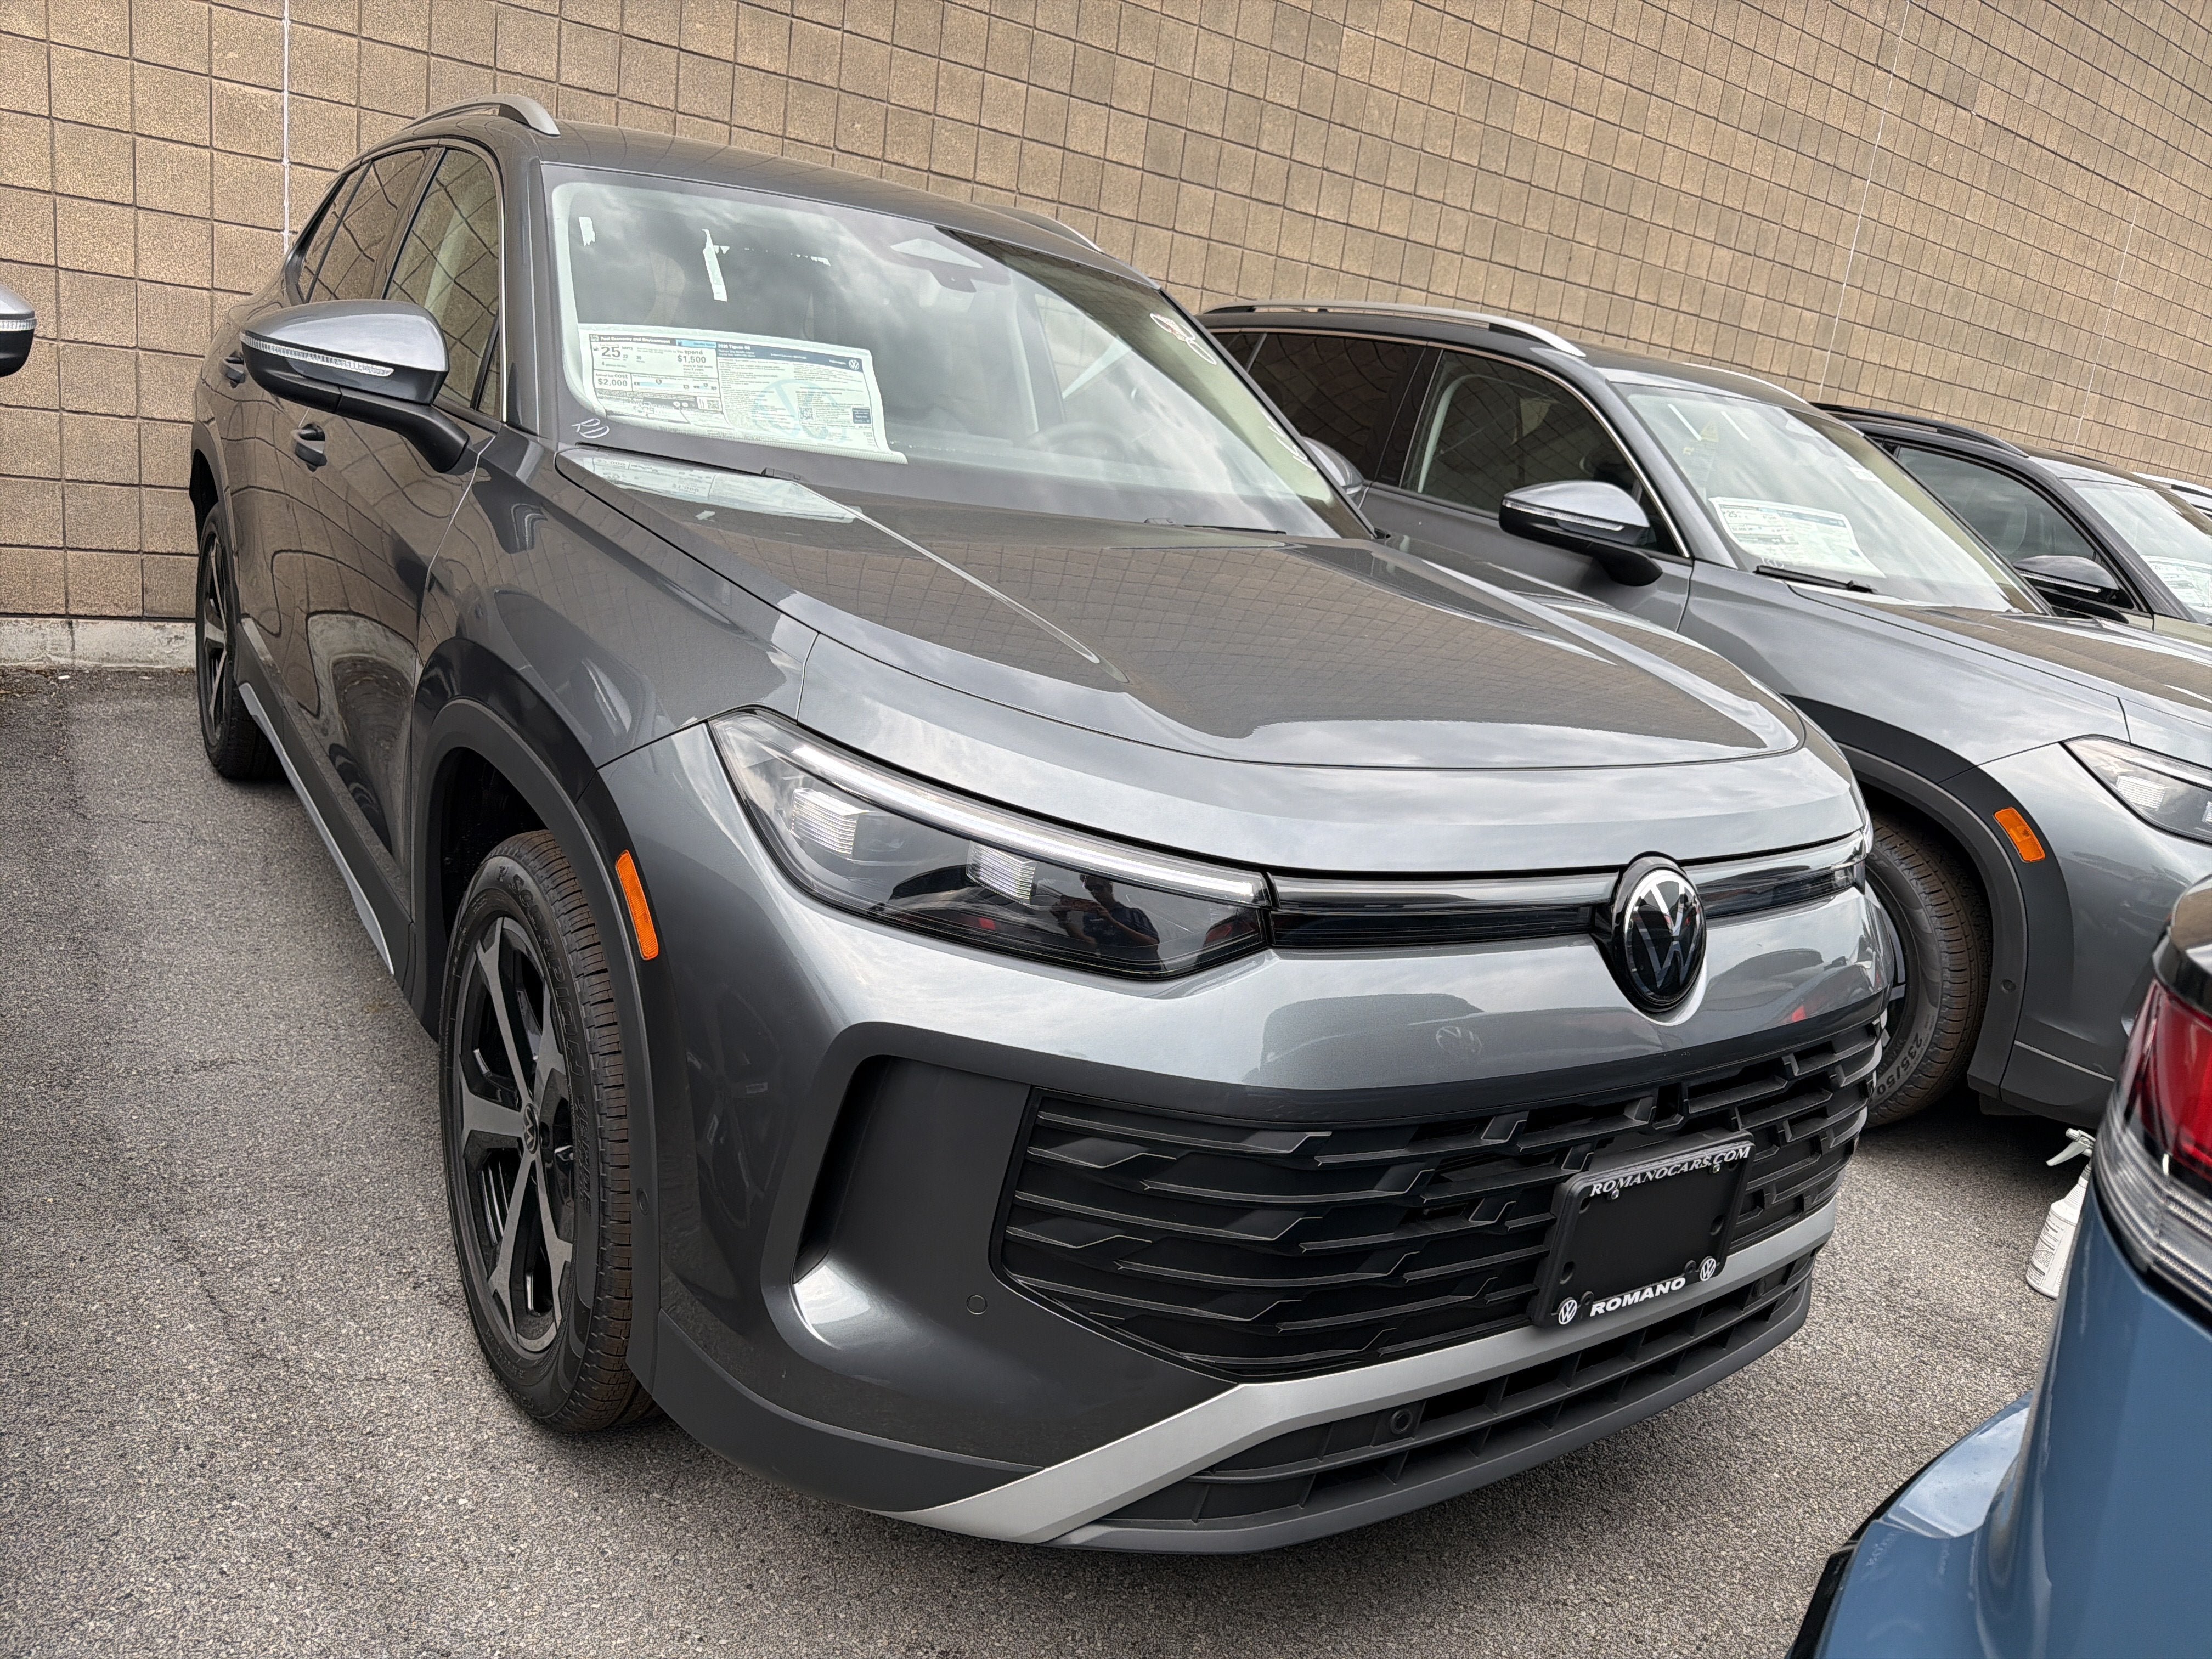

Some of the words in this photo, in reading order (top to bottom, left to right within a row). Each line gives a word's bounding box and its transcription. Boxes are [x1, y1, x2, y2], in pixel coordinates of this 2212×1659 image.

[601, 346, 621, 358] 25
[677, 355, 706, 364] $1,500
[597, 379, 628, 387] $2,000
[1589, 1147, 1751, 1197] ROMANOCARS.COM
[1590, 1277, 1686, 1317] ROMANO
